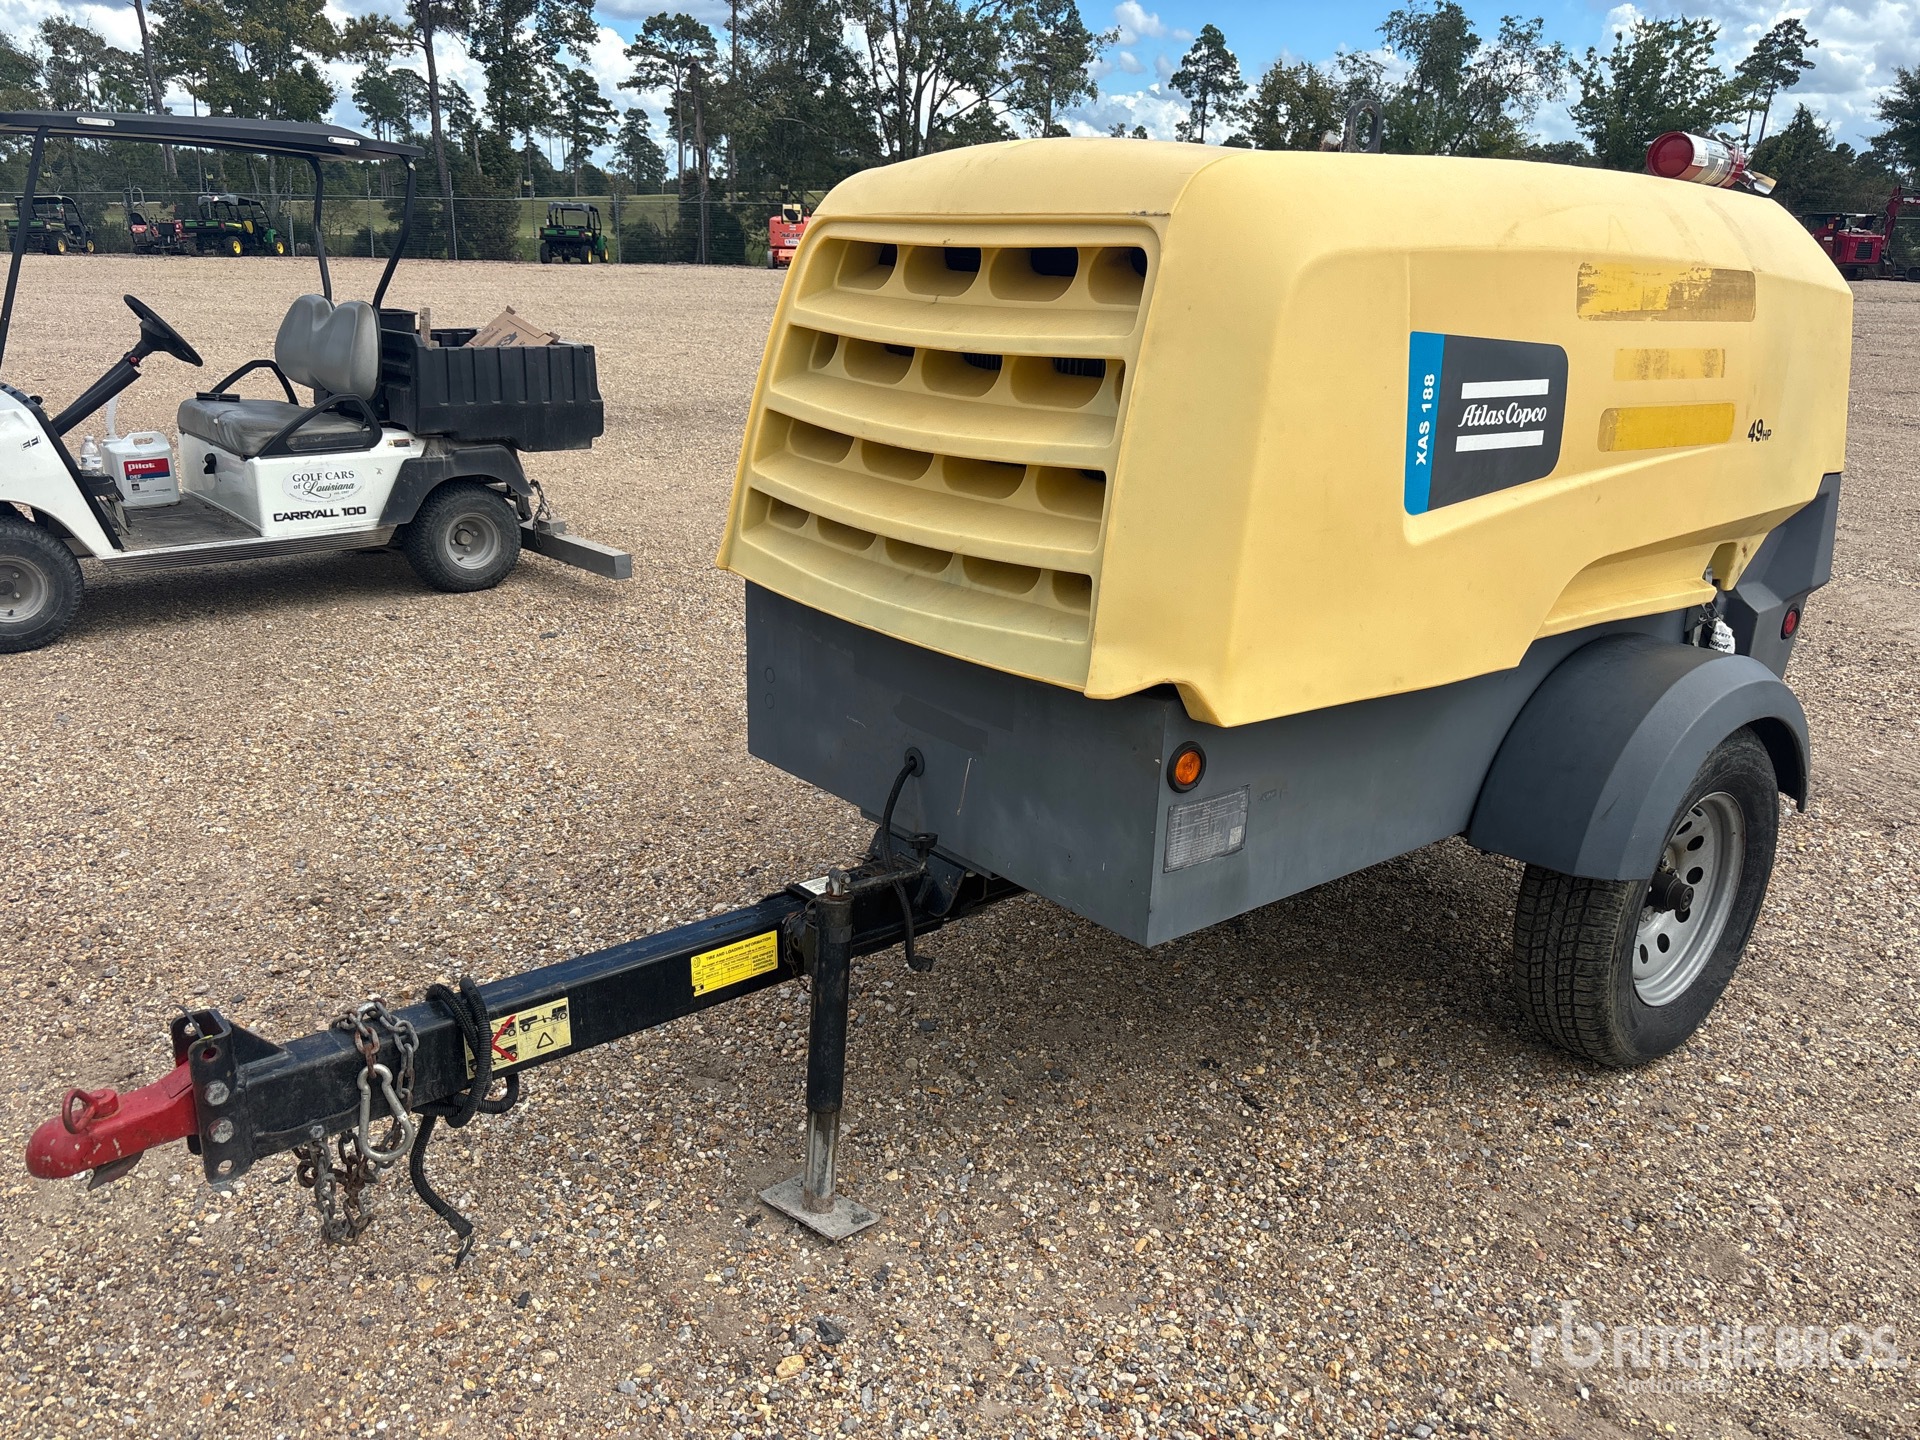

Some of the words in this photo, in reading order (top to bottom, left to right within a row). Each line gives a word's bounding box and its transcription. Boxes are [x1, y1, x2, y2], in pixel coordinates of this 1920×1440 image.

[1421, 373, 1435, 413] 188
[1458, 404, 1504, 428] Atlas
[1505, 402, 1547, 428] Copco
[1415, 420, 1430, 466] XAS
[292, 473, 322, 482] GOLF
[325, 470, 354, 480] CARS
[302, 480, 355, 499] Louisiana
[273, 508, 340, 522] CARRYALL
[341, 506, 367, 516] 100
[725, 946, 745, 955] LOADING
[744, 936, 772, 949] INFORMATION
